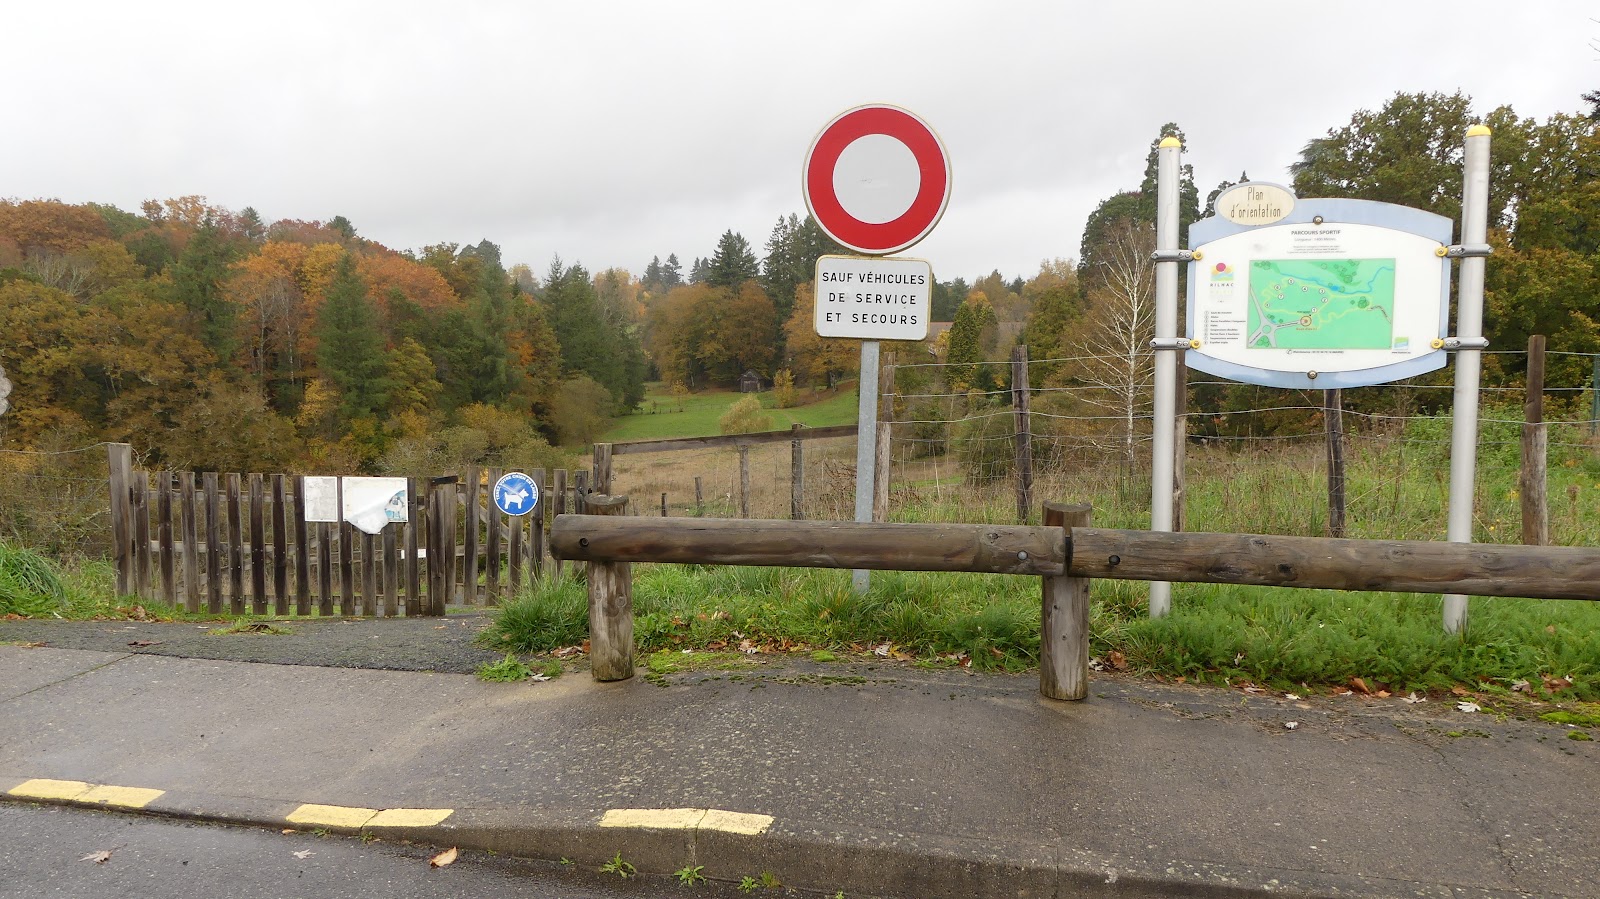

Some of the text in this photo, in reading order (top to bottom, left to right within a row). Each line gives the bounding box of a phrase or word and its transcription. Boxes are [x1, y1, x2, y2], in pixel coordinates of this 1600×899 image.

[1248, 186, 1264, 200] Plan
[822, 271, 925, 284] SAUF VÉHICULES
[828, 292, 917, 305] DE SERVICE
[826, 312, 917, 325] ET SECOURS
[499, 475, 512, 486] VOTRE
